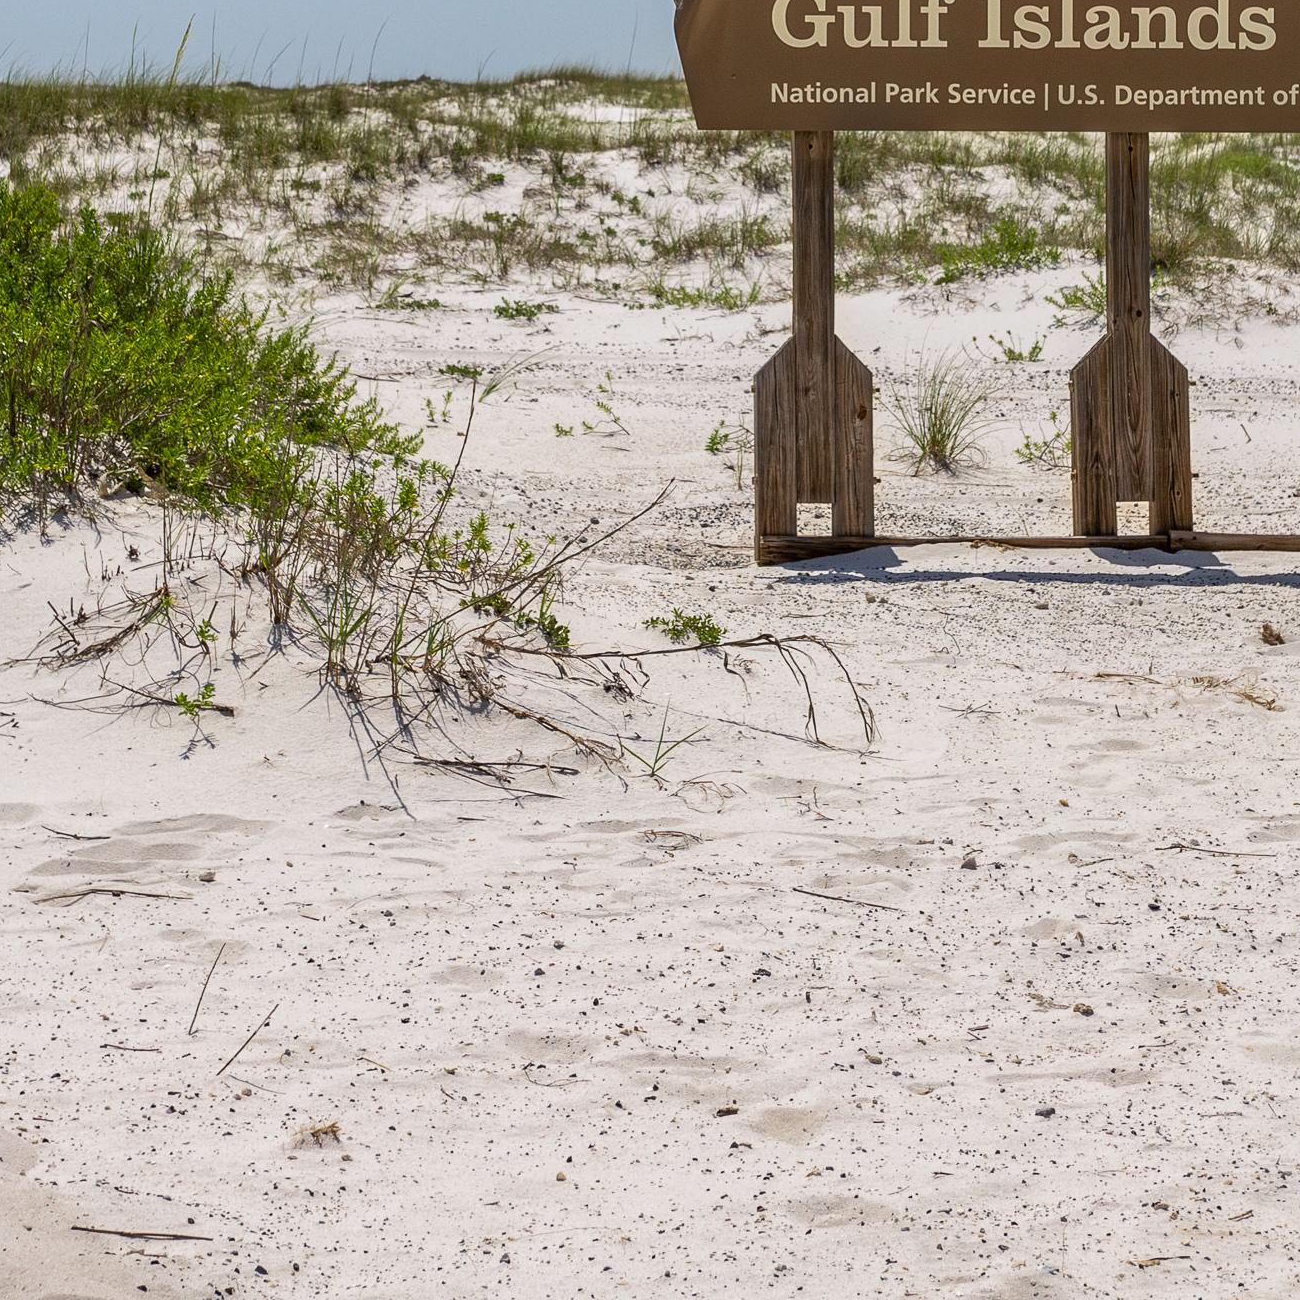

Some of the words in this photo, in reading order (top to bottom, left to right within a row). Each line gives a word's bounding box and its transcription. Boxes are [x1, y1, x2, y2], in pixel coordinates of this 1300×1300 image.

[771, 81, 876, 103] National
[885, 82, 940, 104] Park
[948, 83, 1036, 105] Service
[1058, 84, 1105, 106] U.S.
[1115, 85, 1265, 111] Department
[1272, 83, 1300, 106] of
